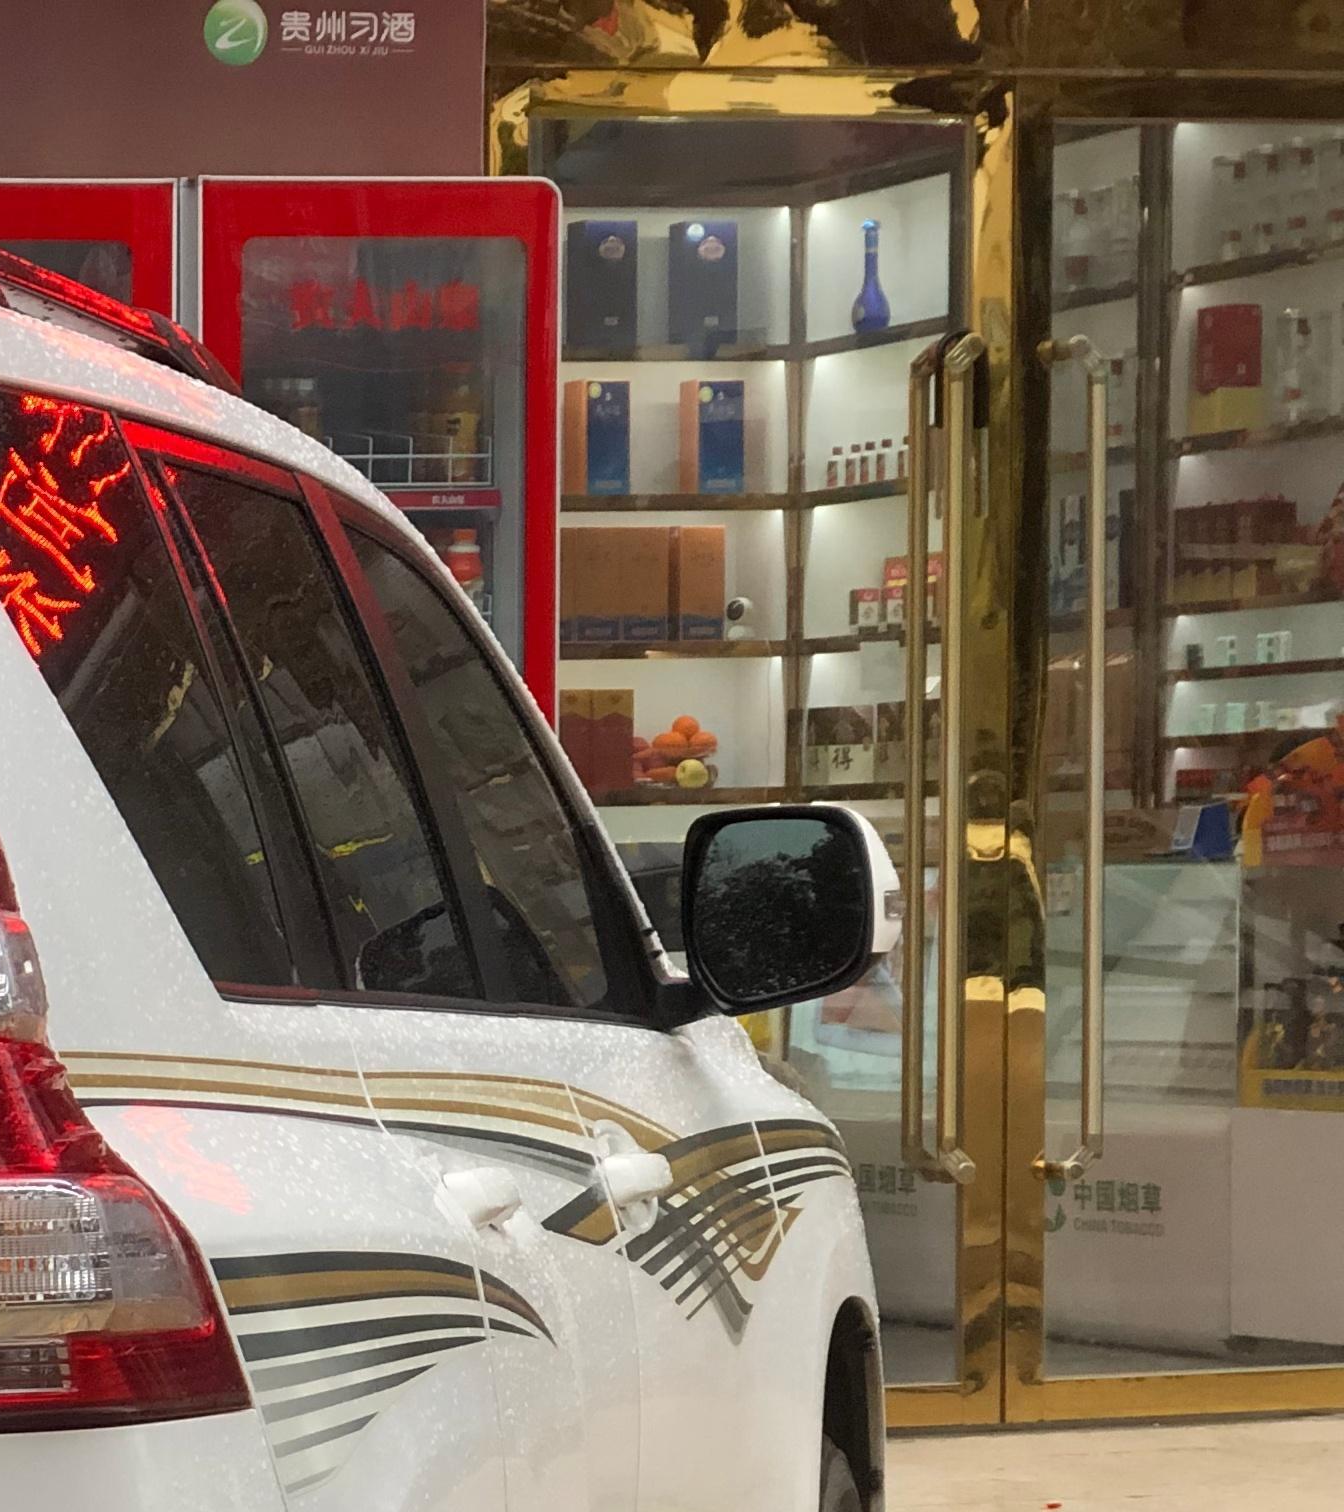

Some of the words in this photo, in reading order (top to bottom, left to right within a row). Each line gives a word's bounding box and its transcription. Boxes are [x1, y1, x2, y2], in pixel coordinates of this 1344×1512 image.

[280, 10, 415, 43] 贵州习酒
[858, 1162, 917, 1196] 国烟草
